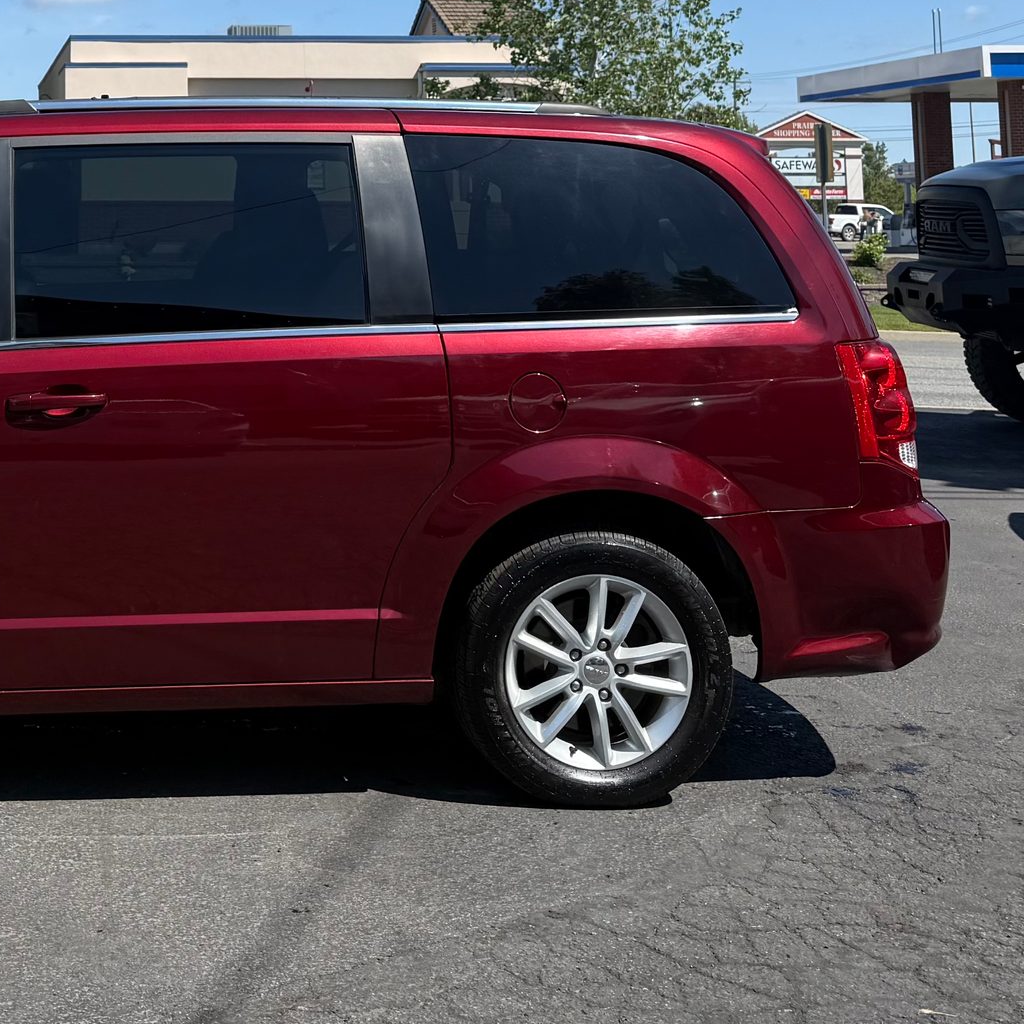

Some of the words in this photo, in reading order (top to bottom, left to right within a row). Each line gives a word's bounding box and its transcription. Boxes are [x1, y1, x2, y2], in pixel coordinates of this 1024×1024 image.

[773, 129, 810, 137] SHOPPING
[774, 160, 816, 170] SAFEWA
[924, 219, 951, 233] RAM
